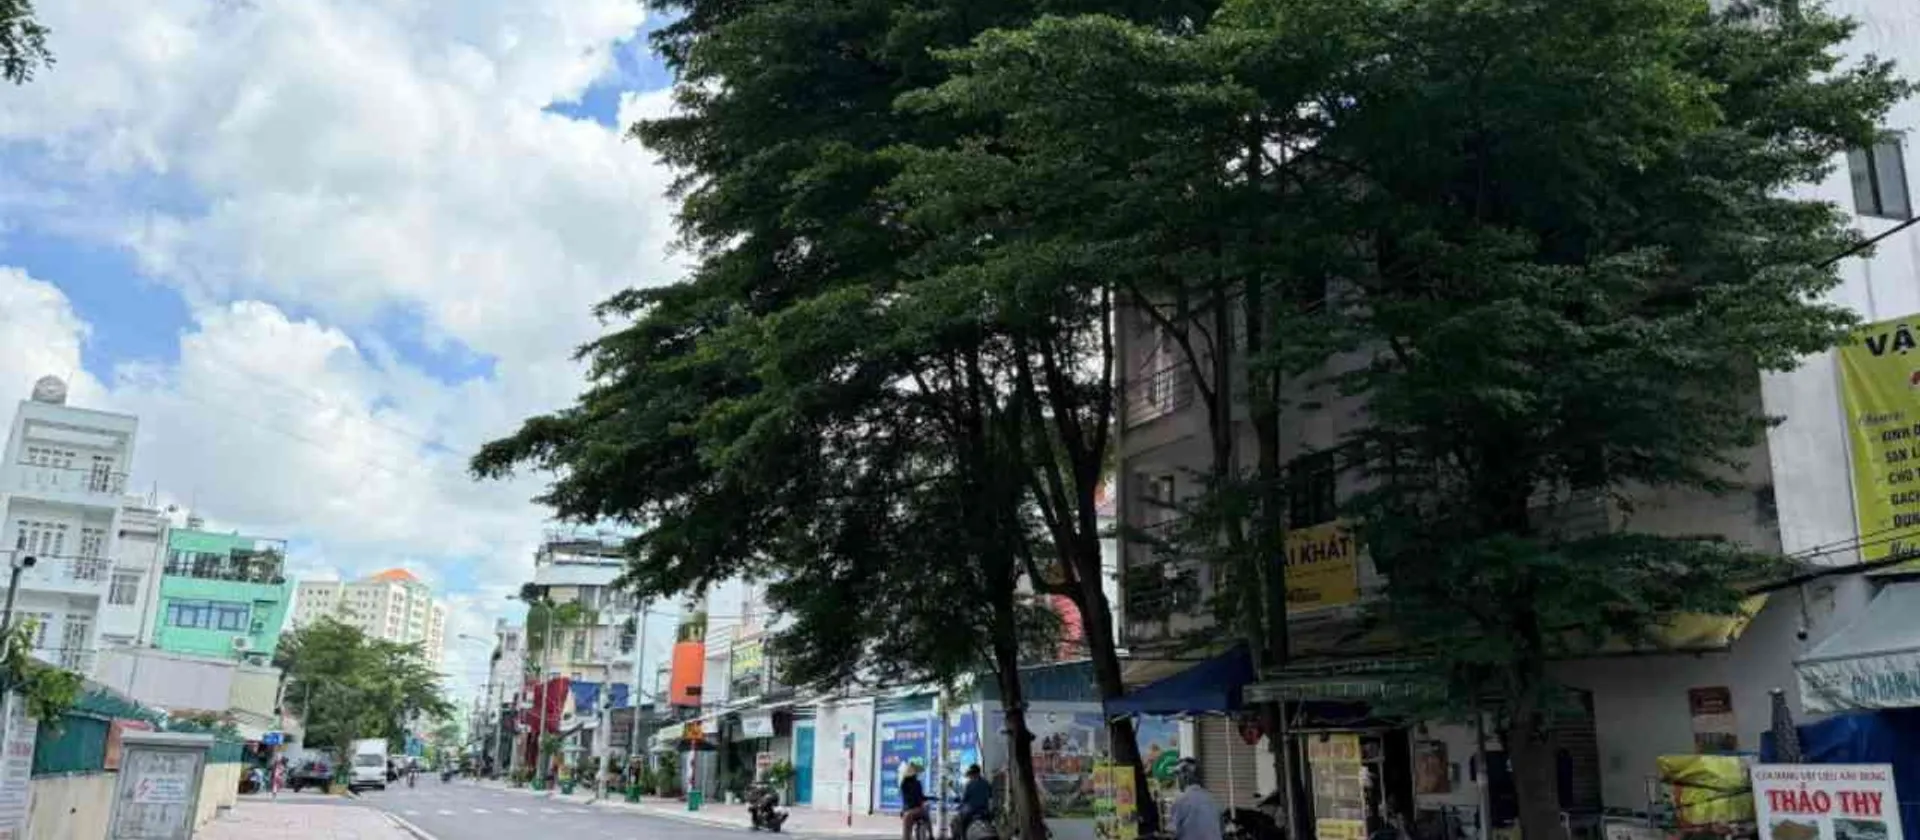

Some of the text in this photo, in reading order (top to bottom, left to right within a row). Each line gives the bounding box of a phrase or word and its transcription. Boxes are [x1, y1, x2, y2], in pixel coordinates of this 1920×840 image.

[1865, 324, 1920, 356] VẬ
[1300, 532, 1349, 564] KHÁT
[1765, 782, 1884, 815] THẢO THY
